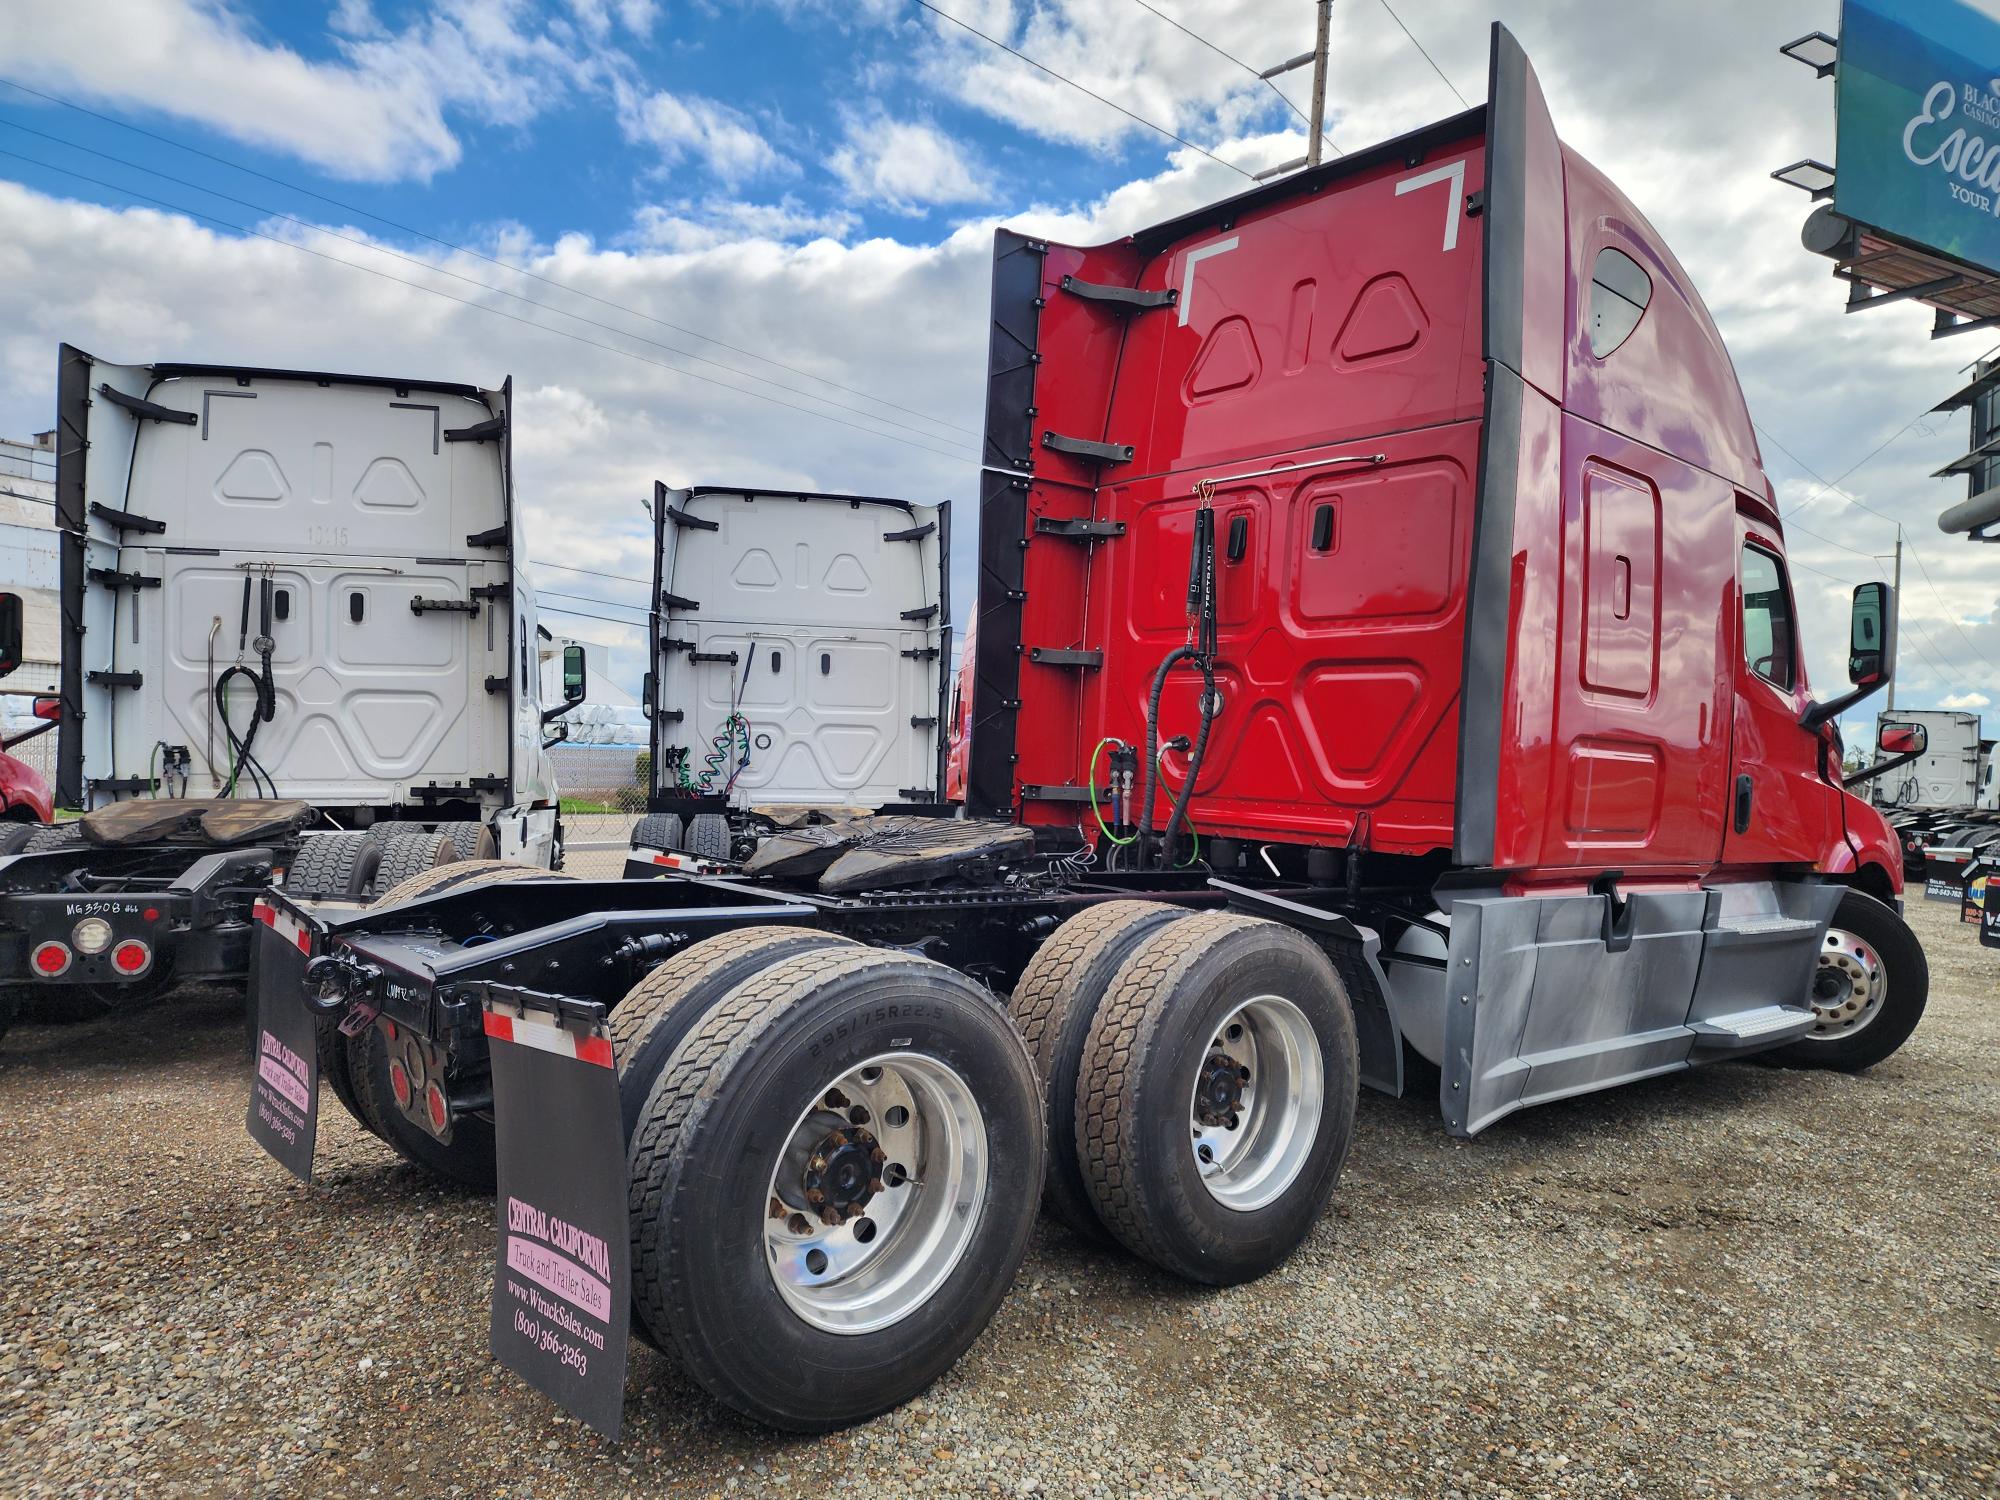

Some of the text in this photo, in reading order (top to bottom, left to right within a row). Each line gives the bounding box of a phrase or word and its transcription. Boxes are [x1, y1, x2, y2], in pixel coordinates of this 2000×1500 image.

[1963, 103, 2000, 129] CASINO
[1964, 84, 2000, 116] BLAC
[1949, 182, 1990, 213] YOUR
[808, 1004, 945, 1058] 295/75R22.5
[262, 1030, 309, 1089] CENTRAL CALIFORNIA
[262, 1060, 305, 1106] Truck and Trailer Sales
[258, 1101, 296, 1146] (800) 366-3263
[507, 1196, 611, 1284] CENTRAL CALIFORNIA
[514, 1244, 602, 1310] Truck and Trailer Sales
[507, 1279, 605, 1351] www.WtruckSales.com
[513, 1308, 587, 1377] (800) 366-3263
